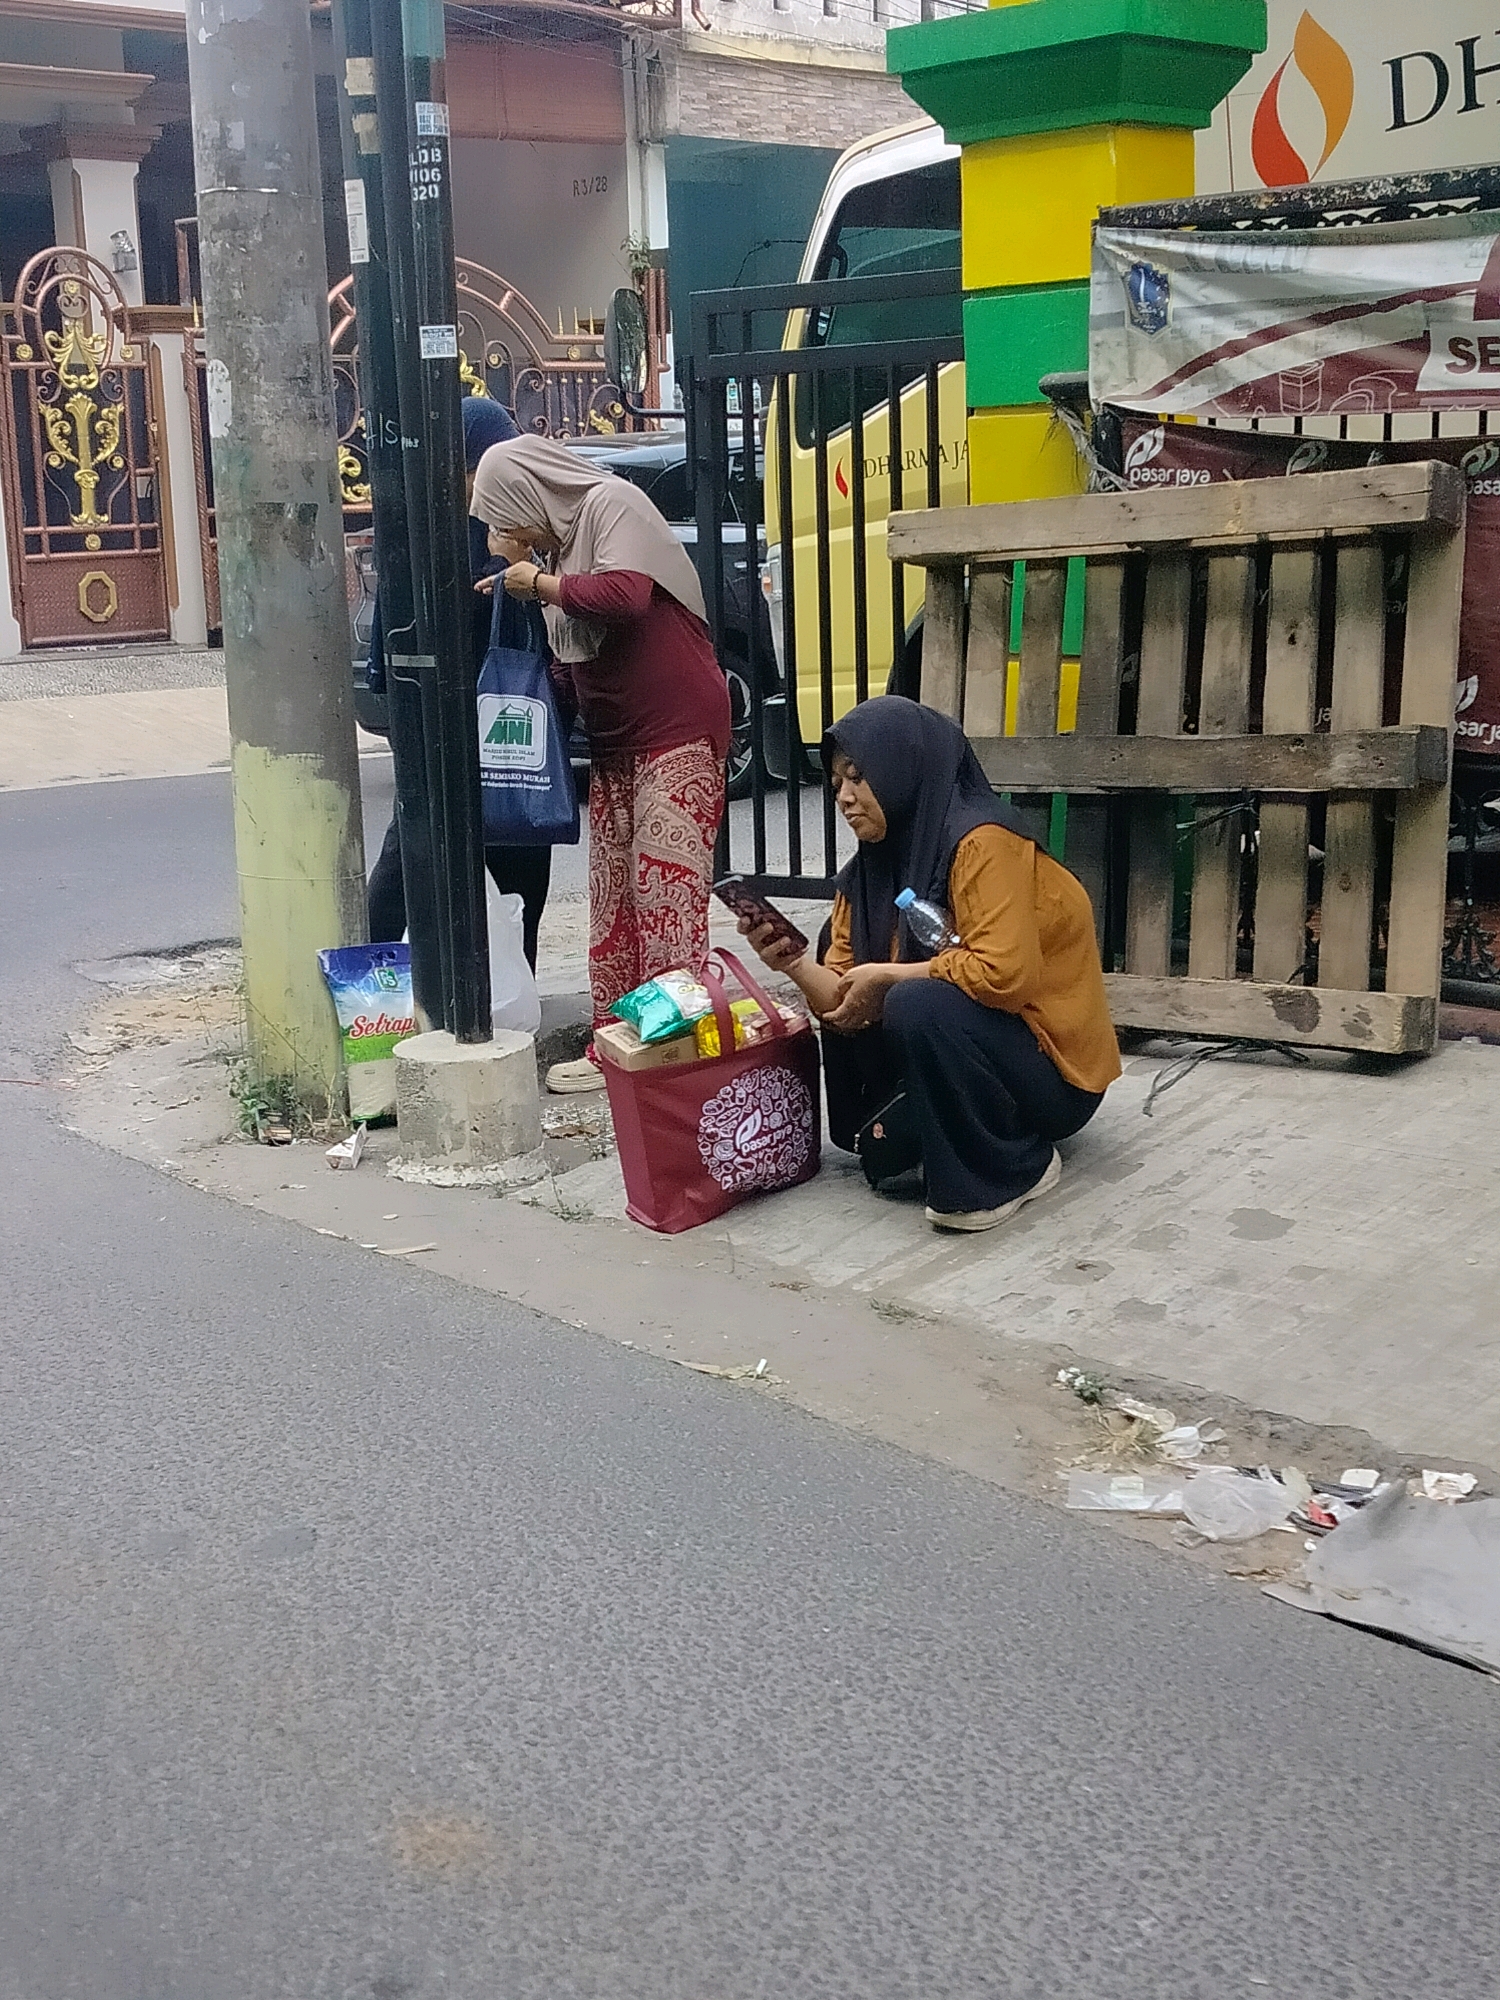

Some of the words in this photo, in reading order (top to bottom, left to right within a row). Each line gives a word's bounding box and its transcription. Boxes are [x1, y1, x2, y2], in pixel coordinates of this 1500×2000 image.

[863, 444, 949, 479] DHRMA
[1130, 467, 1175, 486] pasar
[1175, 468, 1211, 487] jaya
[1468, 479, 1500, 495] asa
[1457, 720, 1490, 737] sar
[742, 1134, 773, 1156] pasar
